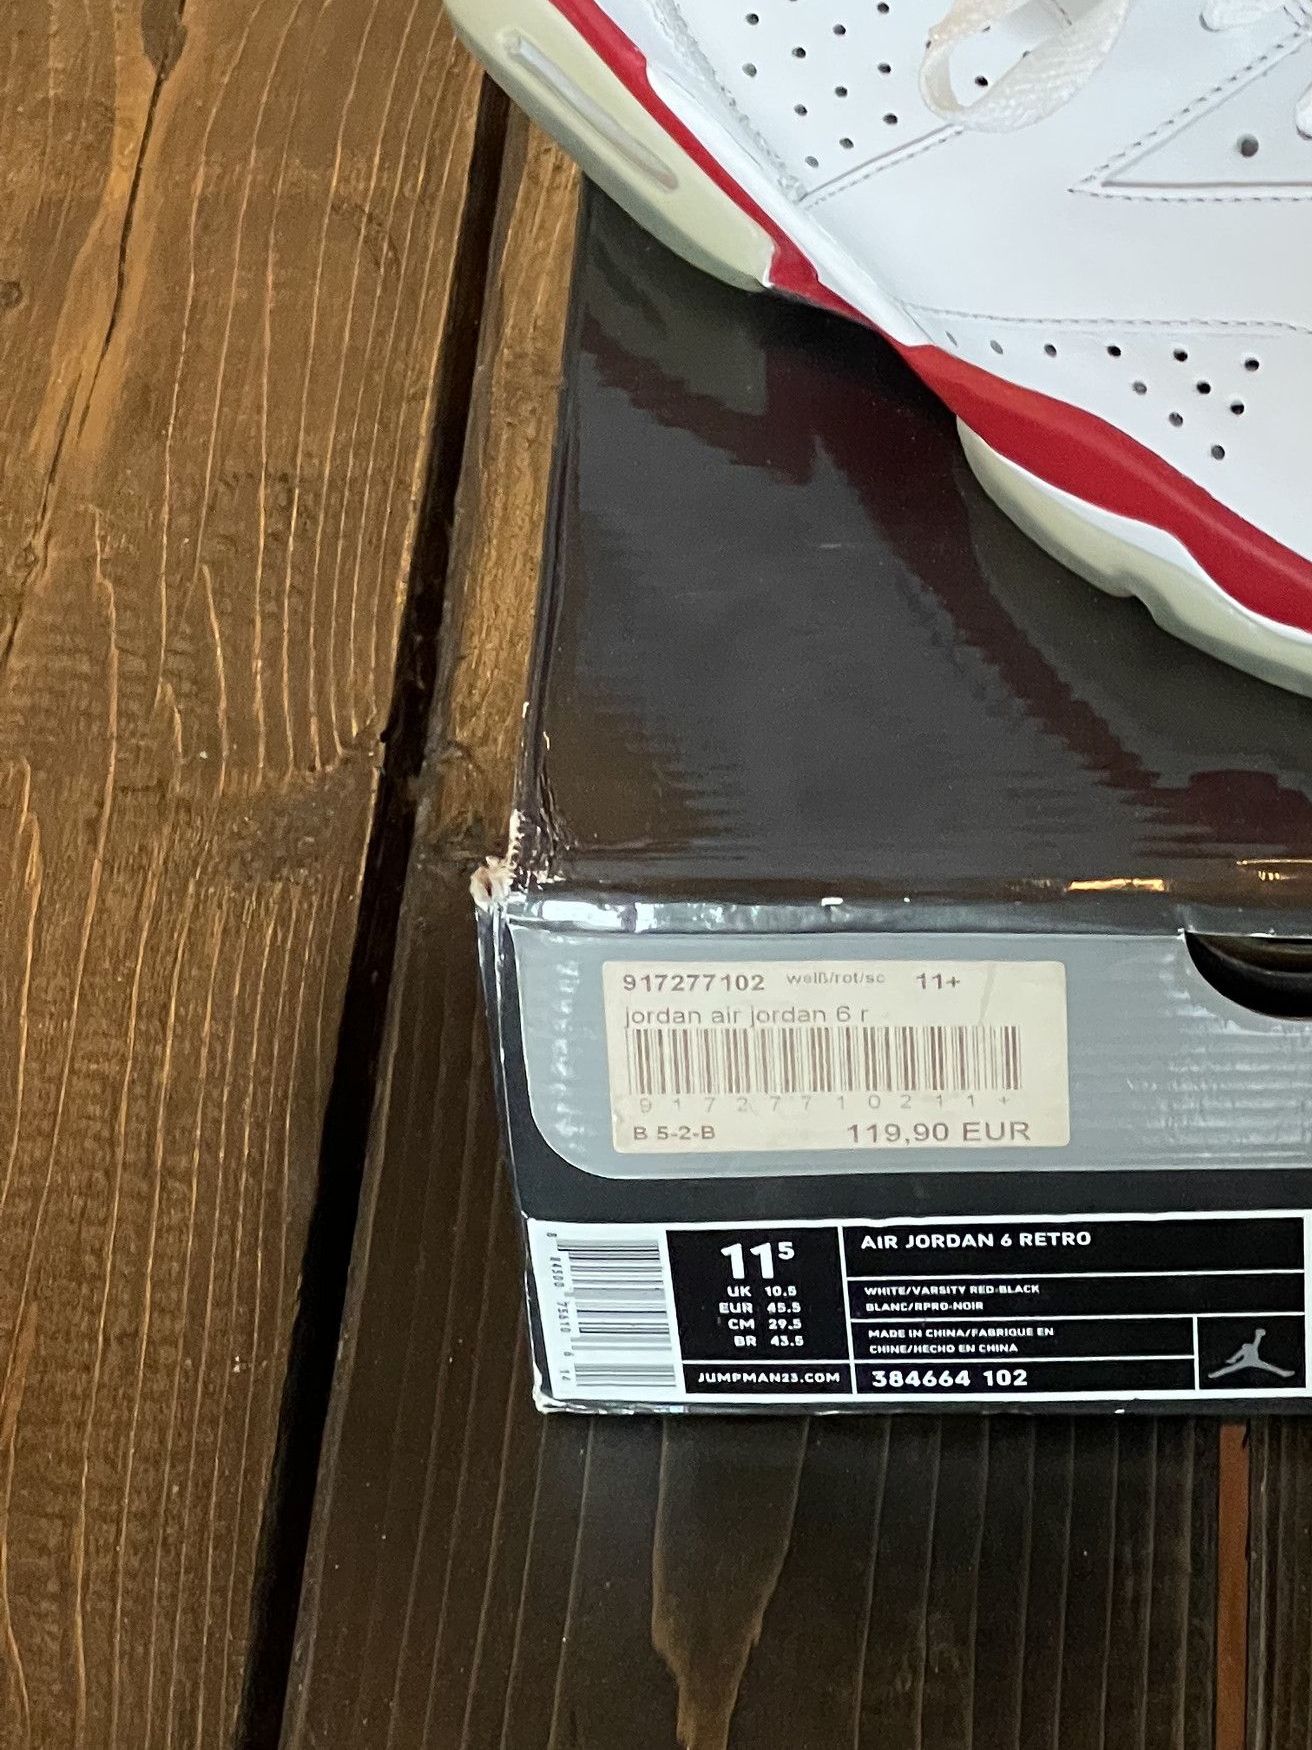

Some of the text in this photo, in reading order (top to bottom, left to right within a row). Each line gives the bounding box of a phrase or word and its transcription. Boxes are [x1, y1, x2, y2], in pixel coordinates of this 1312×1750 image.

[623, 973, 765, 992] 917277102
[916, 972, 961, 990] 11+
[625, 1005, 869, 1028] jordan air jordan 6 r
[633, 1125, 716, 1141] B 5-2-B
[847, 1121, 1031, 1146] 119,90 EUR
[860, 1231, 1091, 1250] AIR JORDAN 6 RETRO
[727, 1285, 797, 1298] UK 10.5
[864, 1284, 1041, 1296] WHITE/VARSITY RED-BLACK
[718, 1302, 801, 1314] EUR 45.5
[727, 1318, 802, 1330] CM 29.5
[868, 1326, 1055, 1339] MADE IN CHINA/FABRIQUE EN
[733, 1335, 804, 1347] BR 43.5
[869, 1343, 1019, 1354] CHINE/HECHO EN CHINA
[698, 1372, 840, 1384] JUMPMAN23.COM
[872, 1368, 1028, 1388] 384664 102
